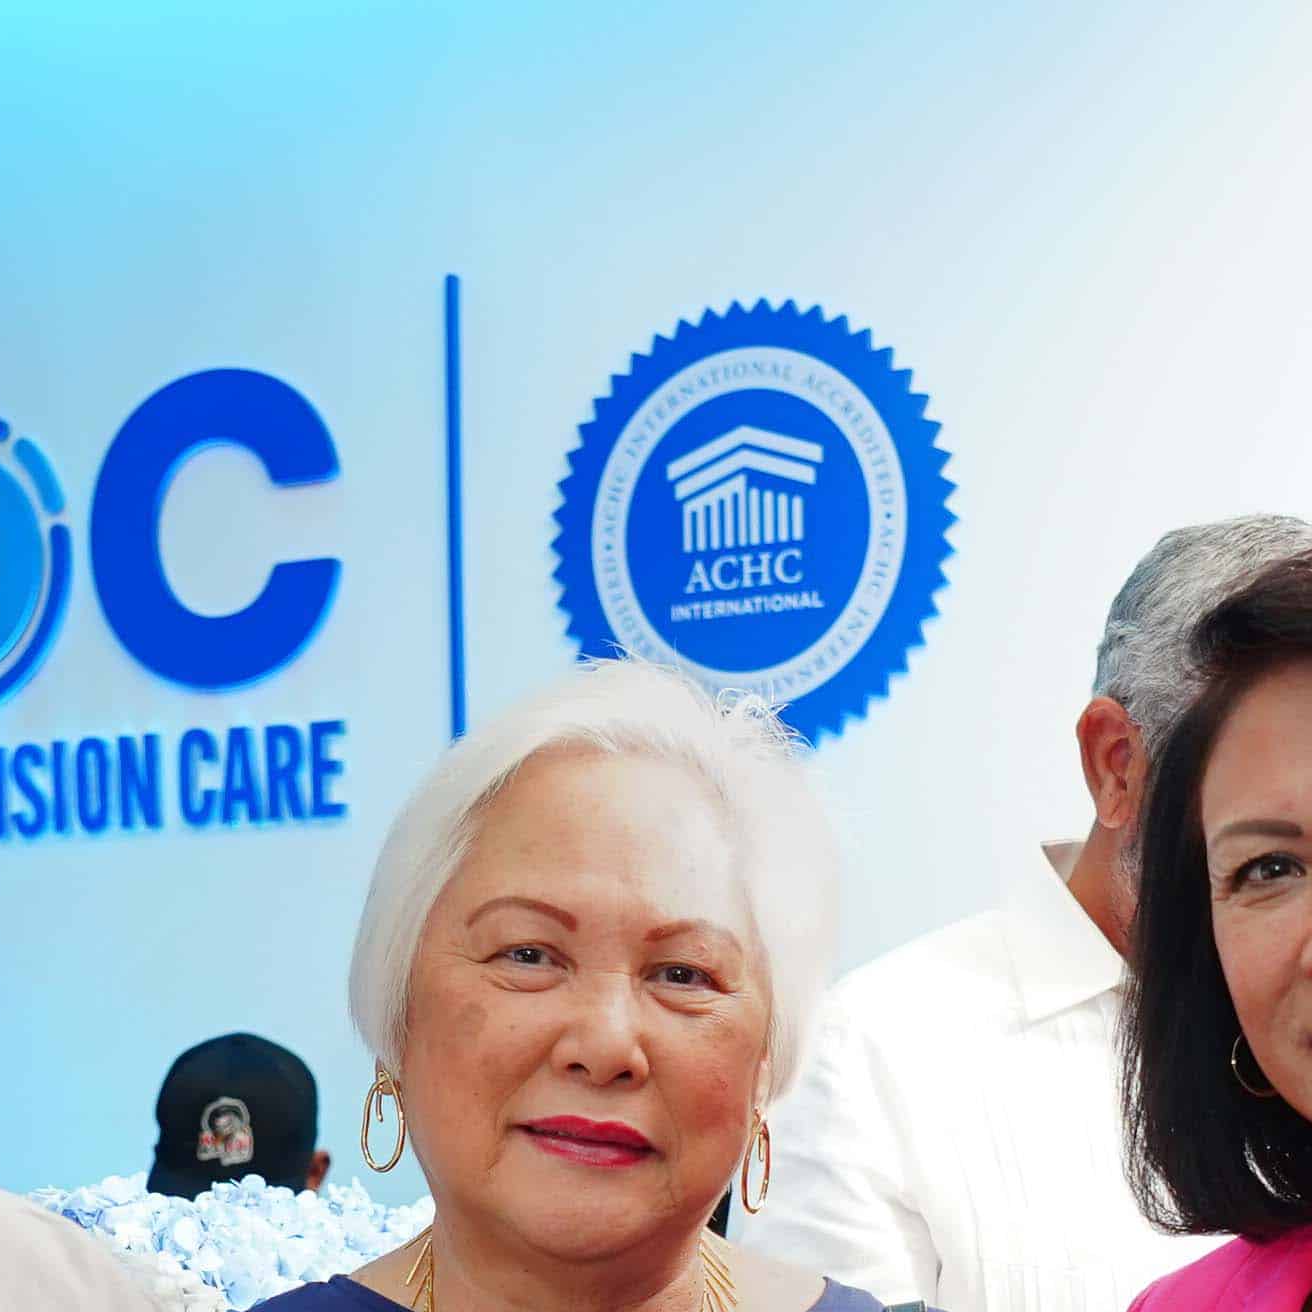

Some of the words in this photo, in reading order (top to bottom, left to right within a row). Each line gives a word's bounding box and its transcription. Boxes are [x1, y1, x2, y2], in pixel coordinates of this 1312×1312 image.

[624, 360, 794, 459] INTERNATIONAL
[803, 372, 895, 505] ACCREDITED
[670, 590, 825, 622] INTERNATIONAL
[685, 549, 803, 593] ACHC
[179, 719, 349, 828] CARE
